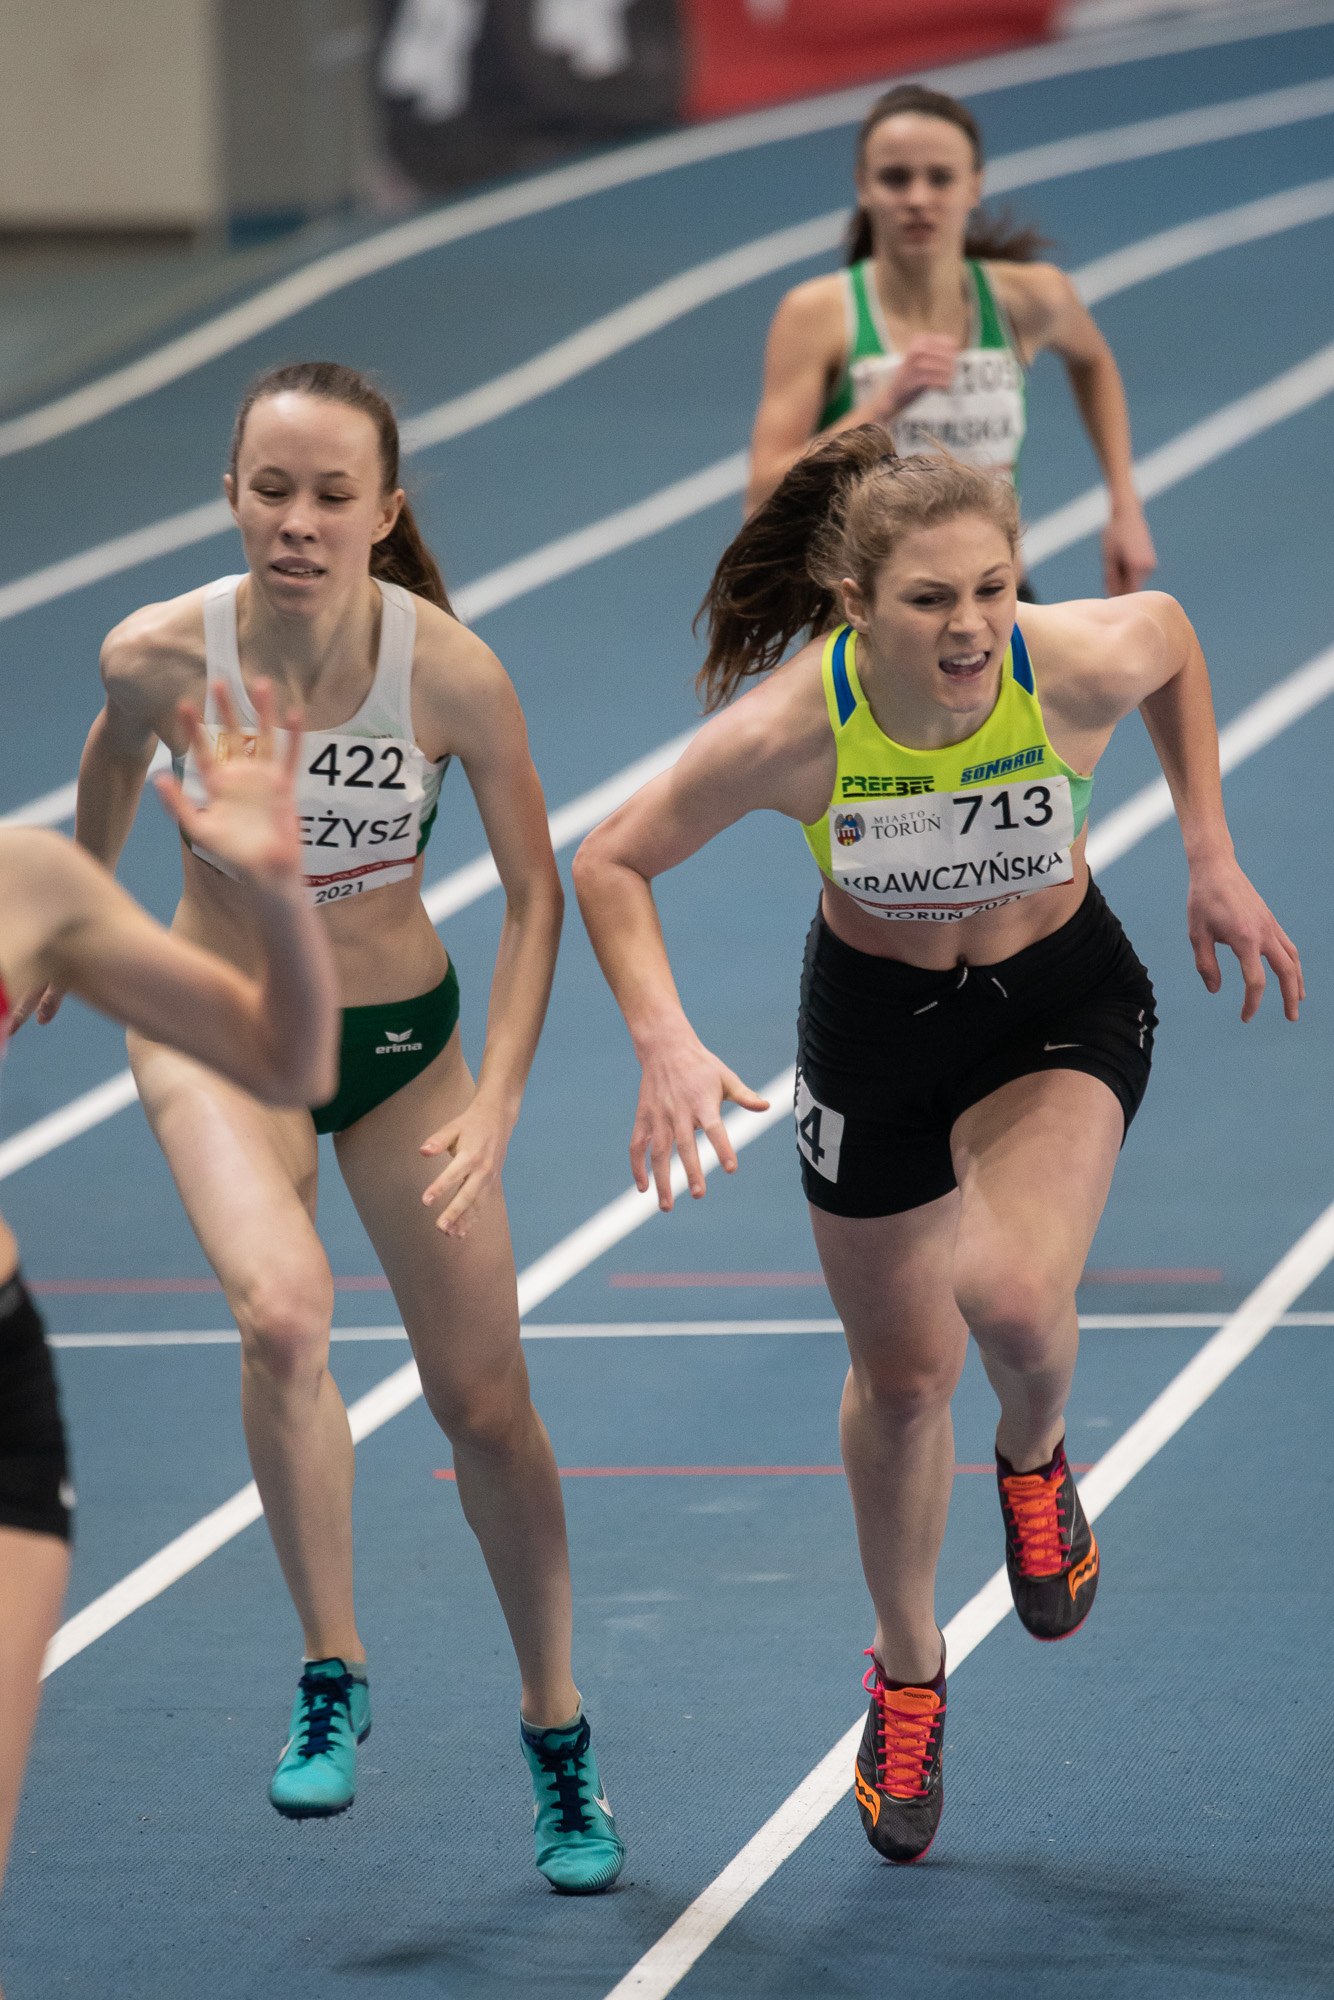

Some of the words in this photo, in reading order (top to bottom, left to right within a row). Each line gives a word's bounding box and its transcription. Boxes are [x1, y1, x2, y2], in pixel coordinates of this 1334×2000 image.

[308, 743, 406, 790] 422
[960, 747, 1045, 784] SONAROL
[297, 809, 412, 848] EŻYSZ
[871, 813, 942, 840] TORUŃ
[874, 810, 926, 824] MIASTO
[953, 786, 1054, 835] 713
[843, 851, 1063, 894] KRAWCZYŃSKA
[315, 881, 363, 904] 2021
[884, 910, 963, 920] TORUŃ
[375, 1042, 422, 1055] erima
[799, 1105, 825, 1166] 4
